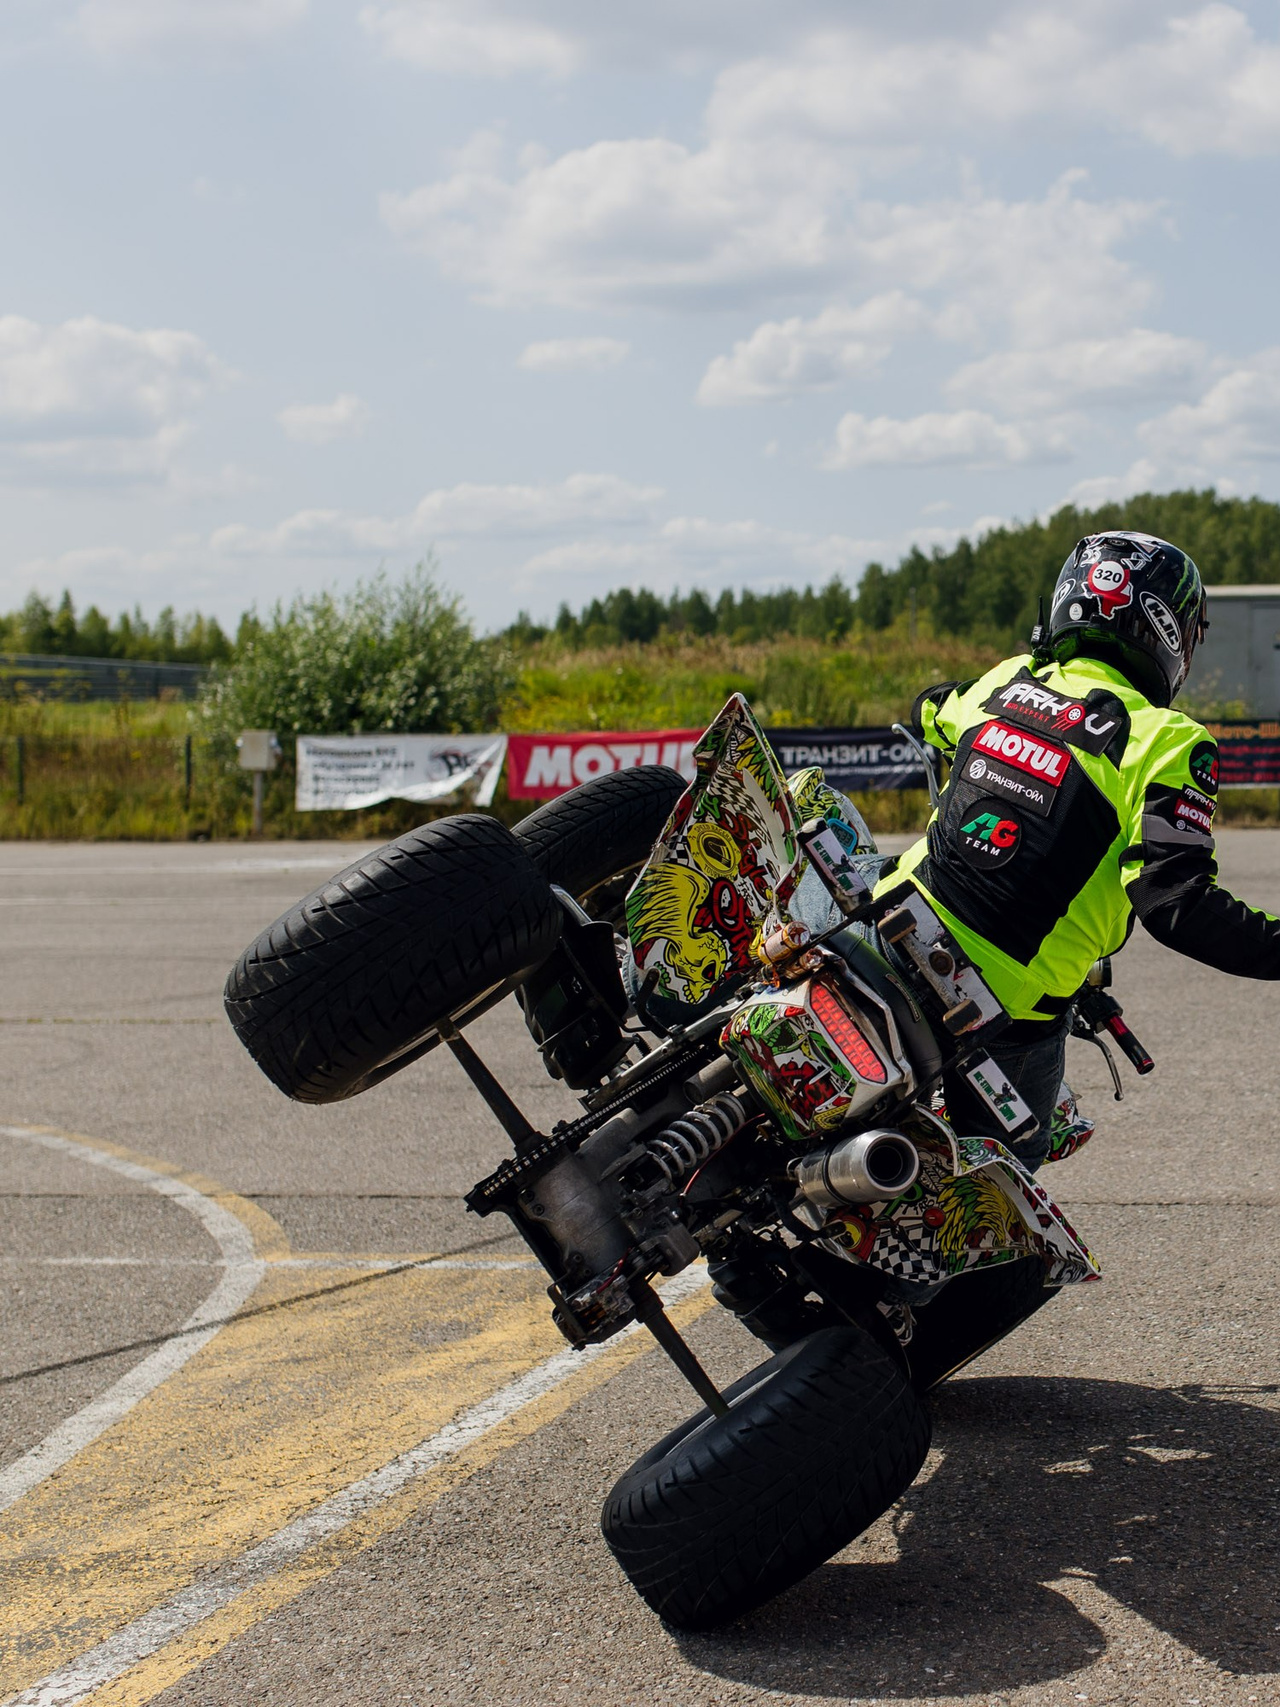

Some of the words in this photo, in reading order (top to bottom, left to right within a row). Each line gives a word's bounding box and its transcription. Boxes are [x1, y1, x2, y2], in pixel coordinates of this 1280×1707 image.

[1094, 568, 1122, 584] 320
[1147, 602, 1179, 646] HJC
[1018, 706, 1051, 723] EXPERT
[978, 725, 1063, 779] MOTUL
[986, 770, 1045, 805] ТРАНЗИТ-ОЙЛ
[1197, 769, 1216, 787] TEAM
[965, 836, 1001, 857] TEAM
